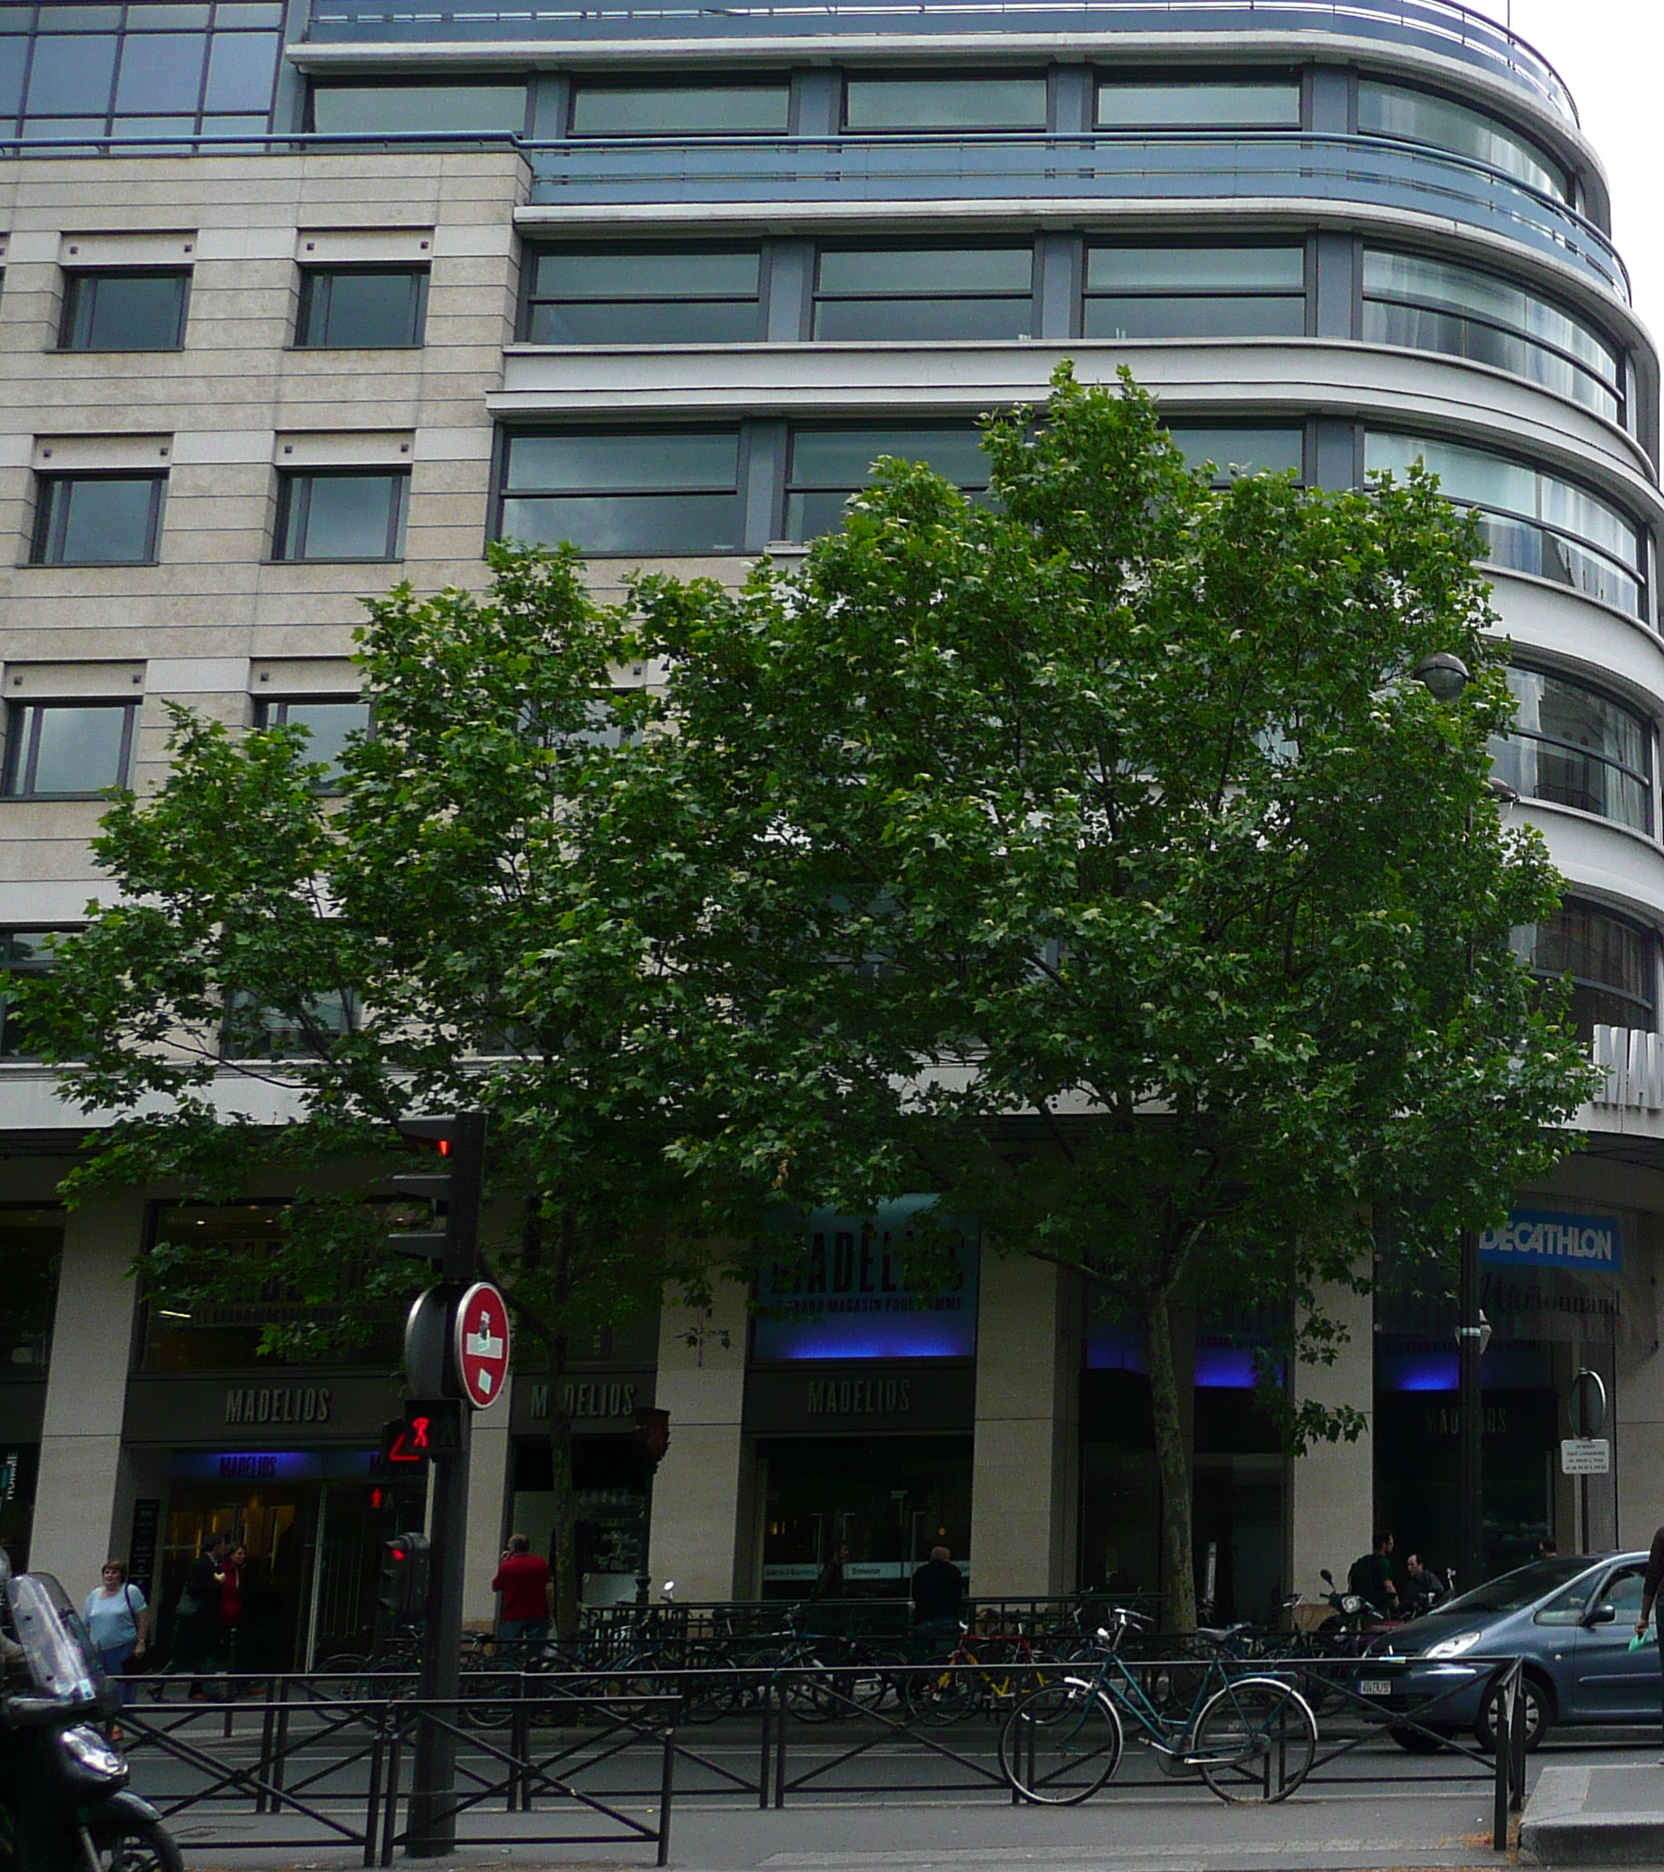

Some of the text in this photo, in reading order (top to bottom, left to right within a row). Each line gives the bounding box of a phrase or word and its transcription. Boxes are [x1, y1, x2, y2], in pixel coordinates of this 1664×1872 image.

[1478, 1220, 1613, 1262] DECATHLON
[828, 1298, 882, 1313] MAGASIN
[225, 1387, 331, 1424] MADELIOS
[530, 1383, 636, 1418] MDELIOS
[807, 1379, 914, 1414] MADELIOS
[219, 1456, 277, 1479] MADELIOS
